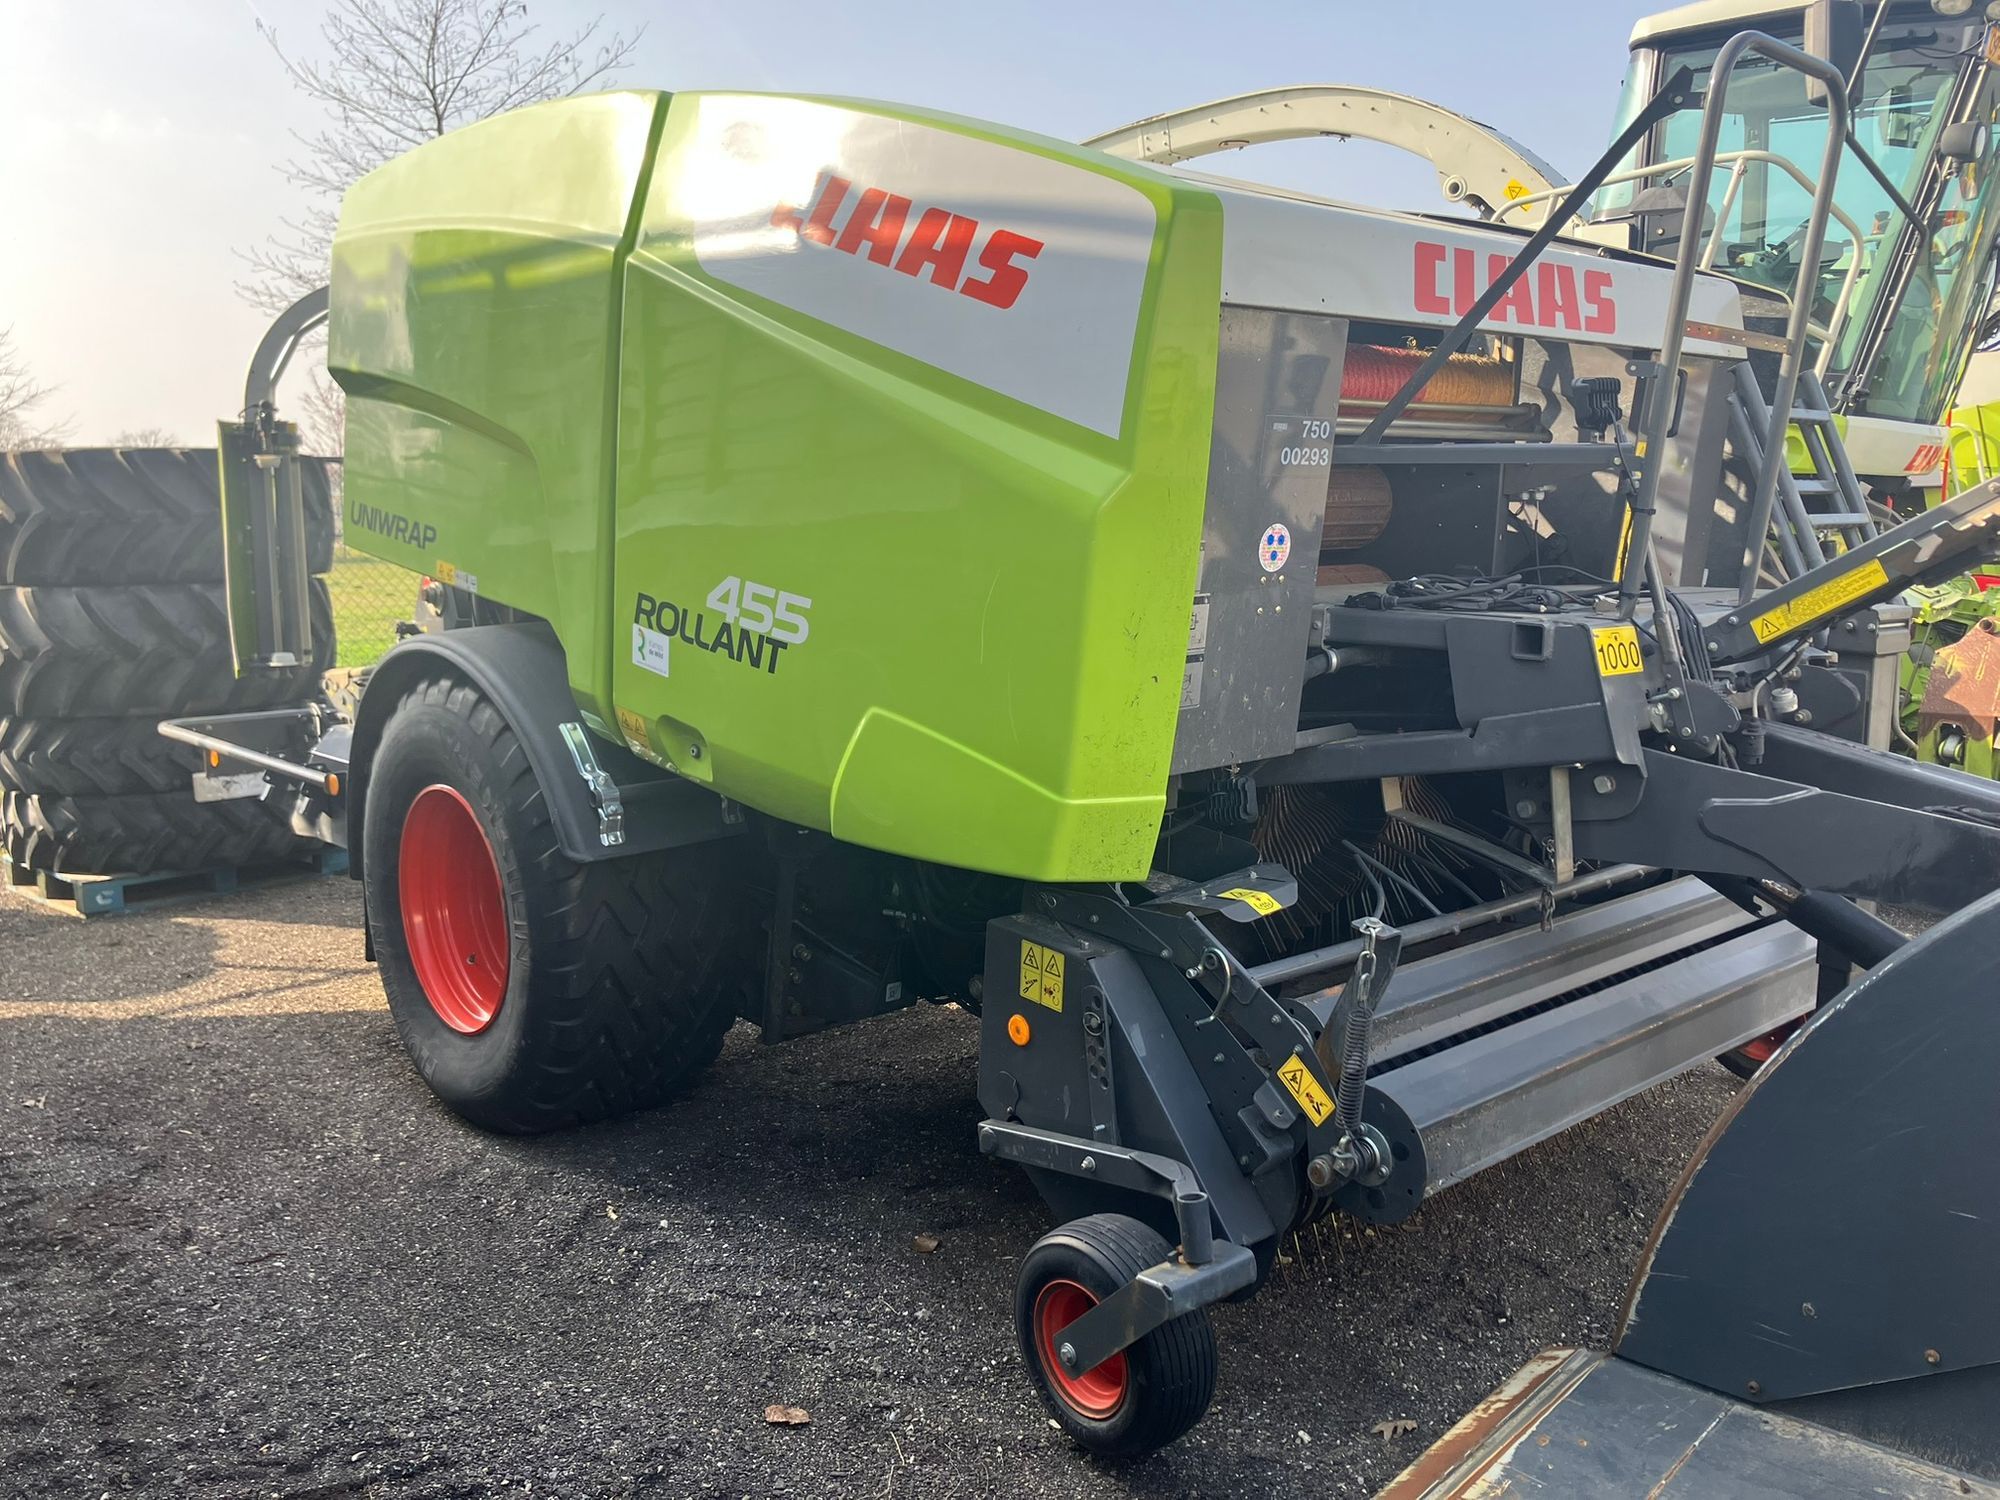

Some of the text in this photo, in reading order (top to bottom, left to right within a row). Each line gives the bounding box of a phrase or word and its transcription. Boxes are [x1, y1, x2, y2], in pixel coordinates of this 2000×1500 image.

[1414, 241, 1616, 334] CLAAS
[1302, 420, 1330, 438] 750
[1280, 447, 1329, 466] 00293
[350, 500, 437, 549] UNIWRAP
[634, 592, 788, 674] ROLLANT
[706, 576, 812, 645] 455
[1598, 641, 1640, 671] 1000
